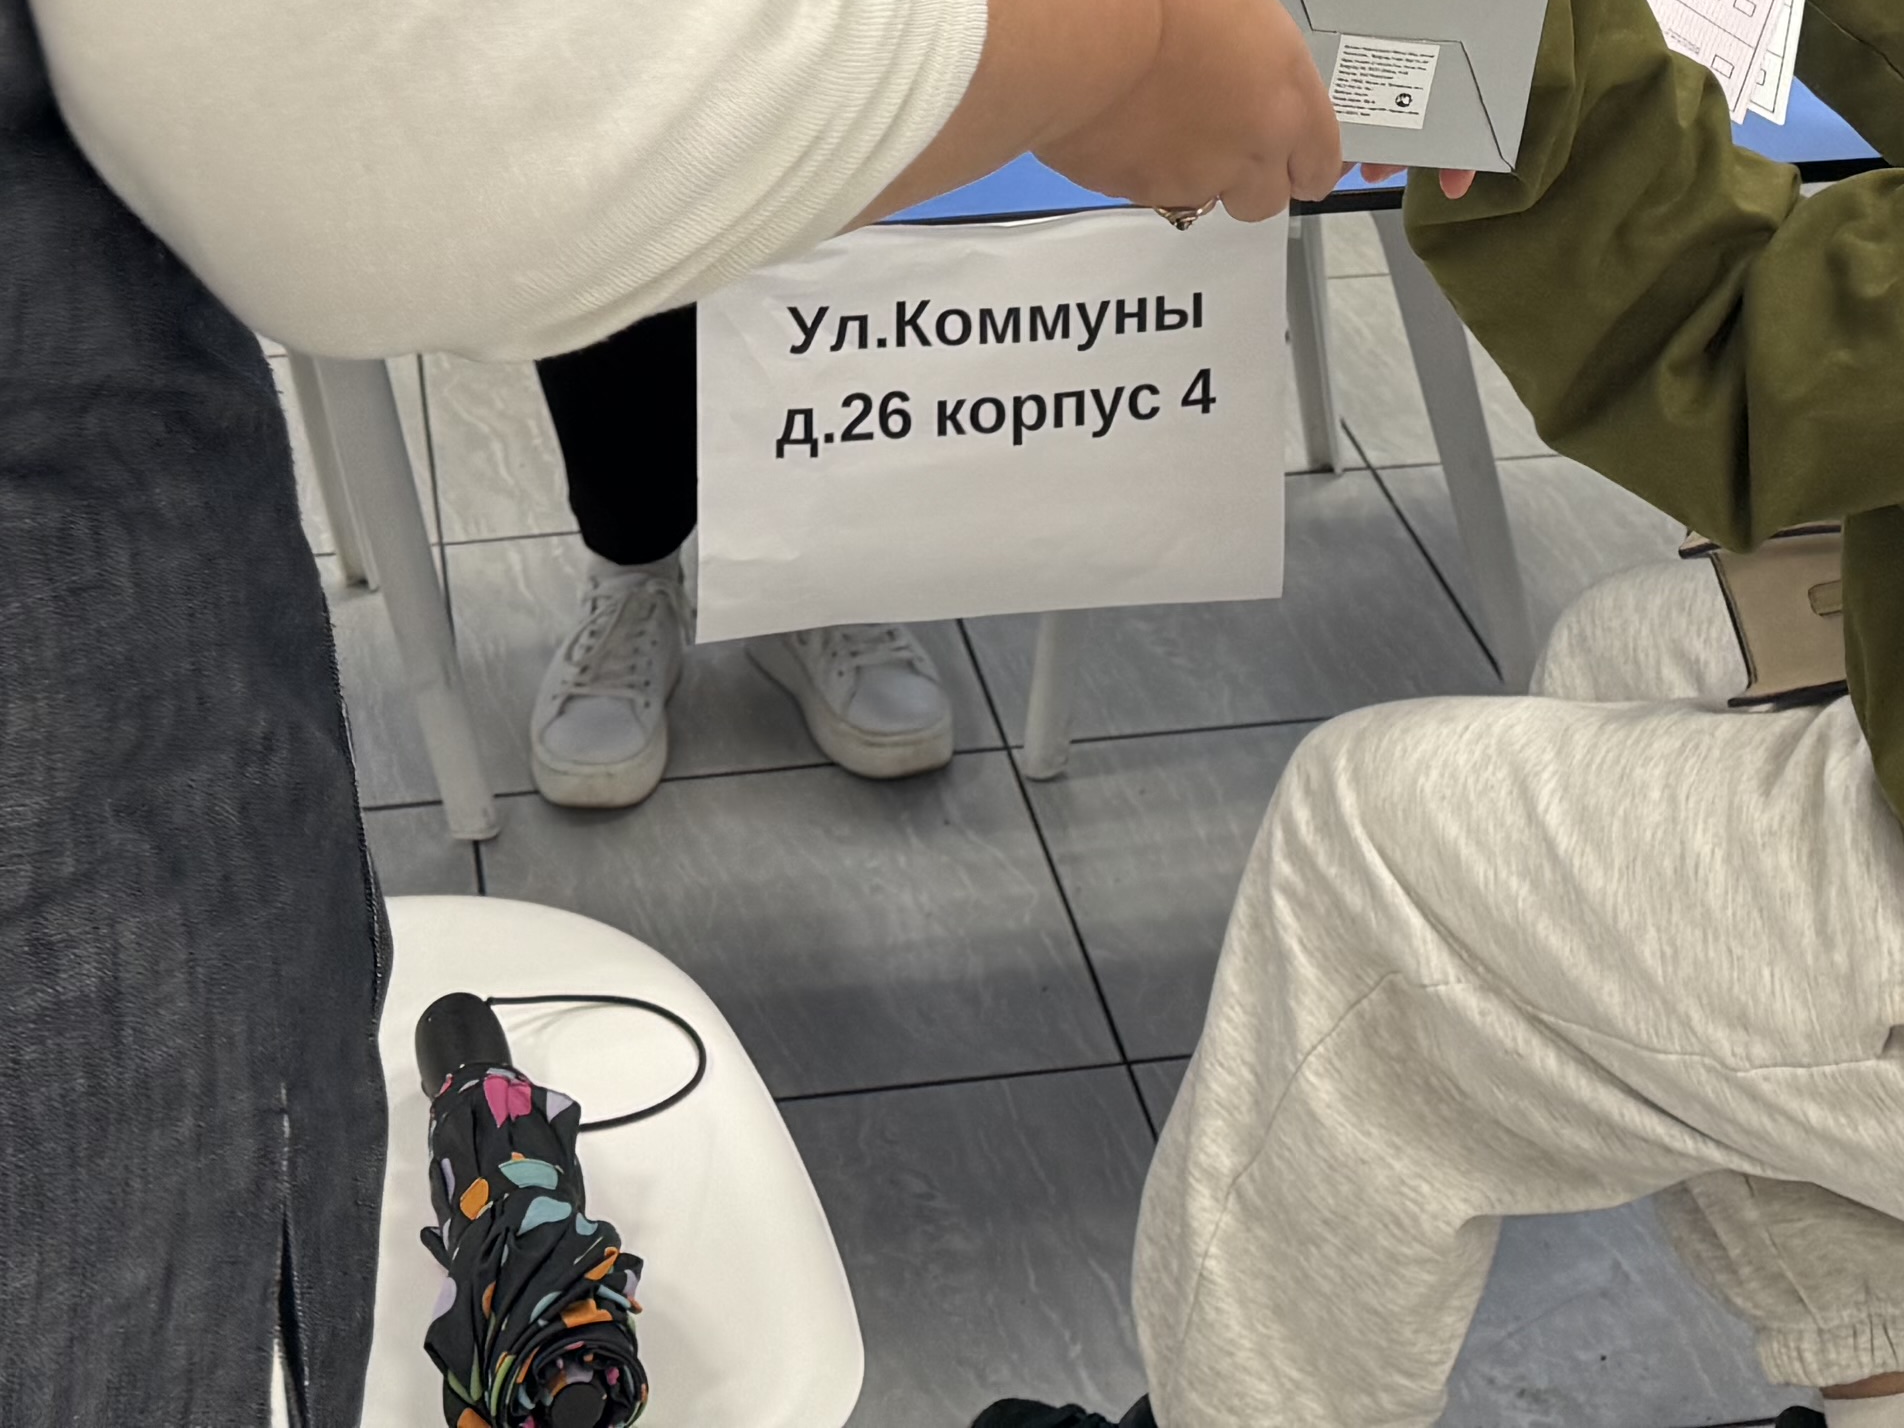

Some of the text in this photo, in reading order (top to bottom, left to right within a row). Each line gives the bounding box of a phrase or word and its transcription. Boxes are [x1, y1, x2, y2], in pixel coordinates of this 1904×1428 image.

[786, 291, 1205, 356] Ул.Коммуны
[775, 367, 1217, 460] д.26 корпус 4
